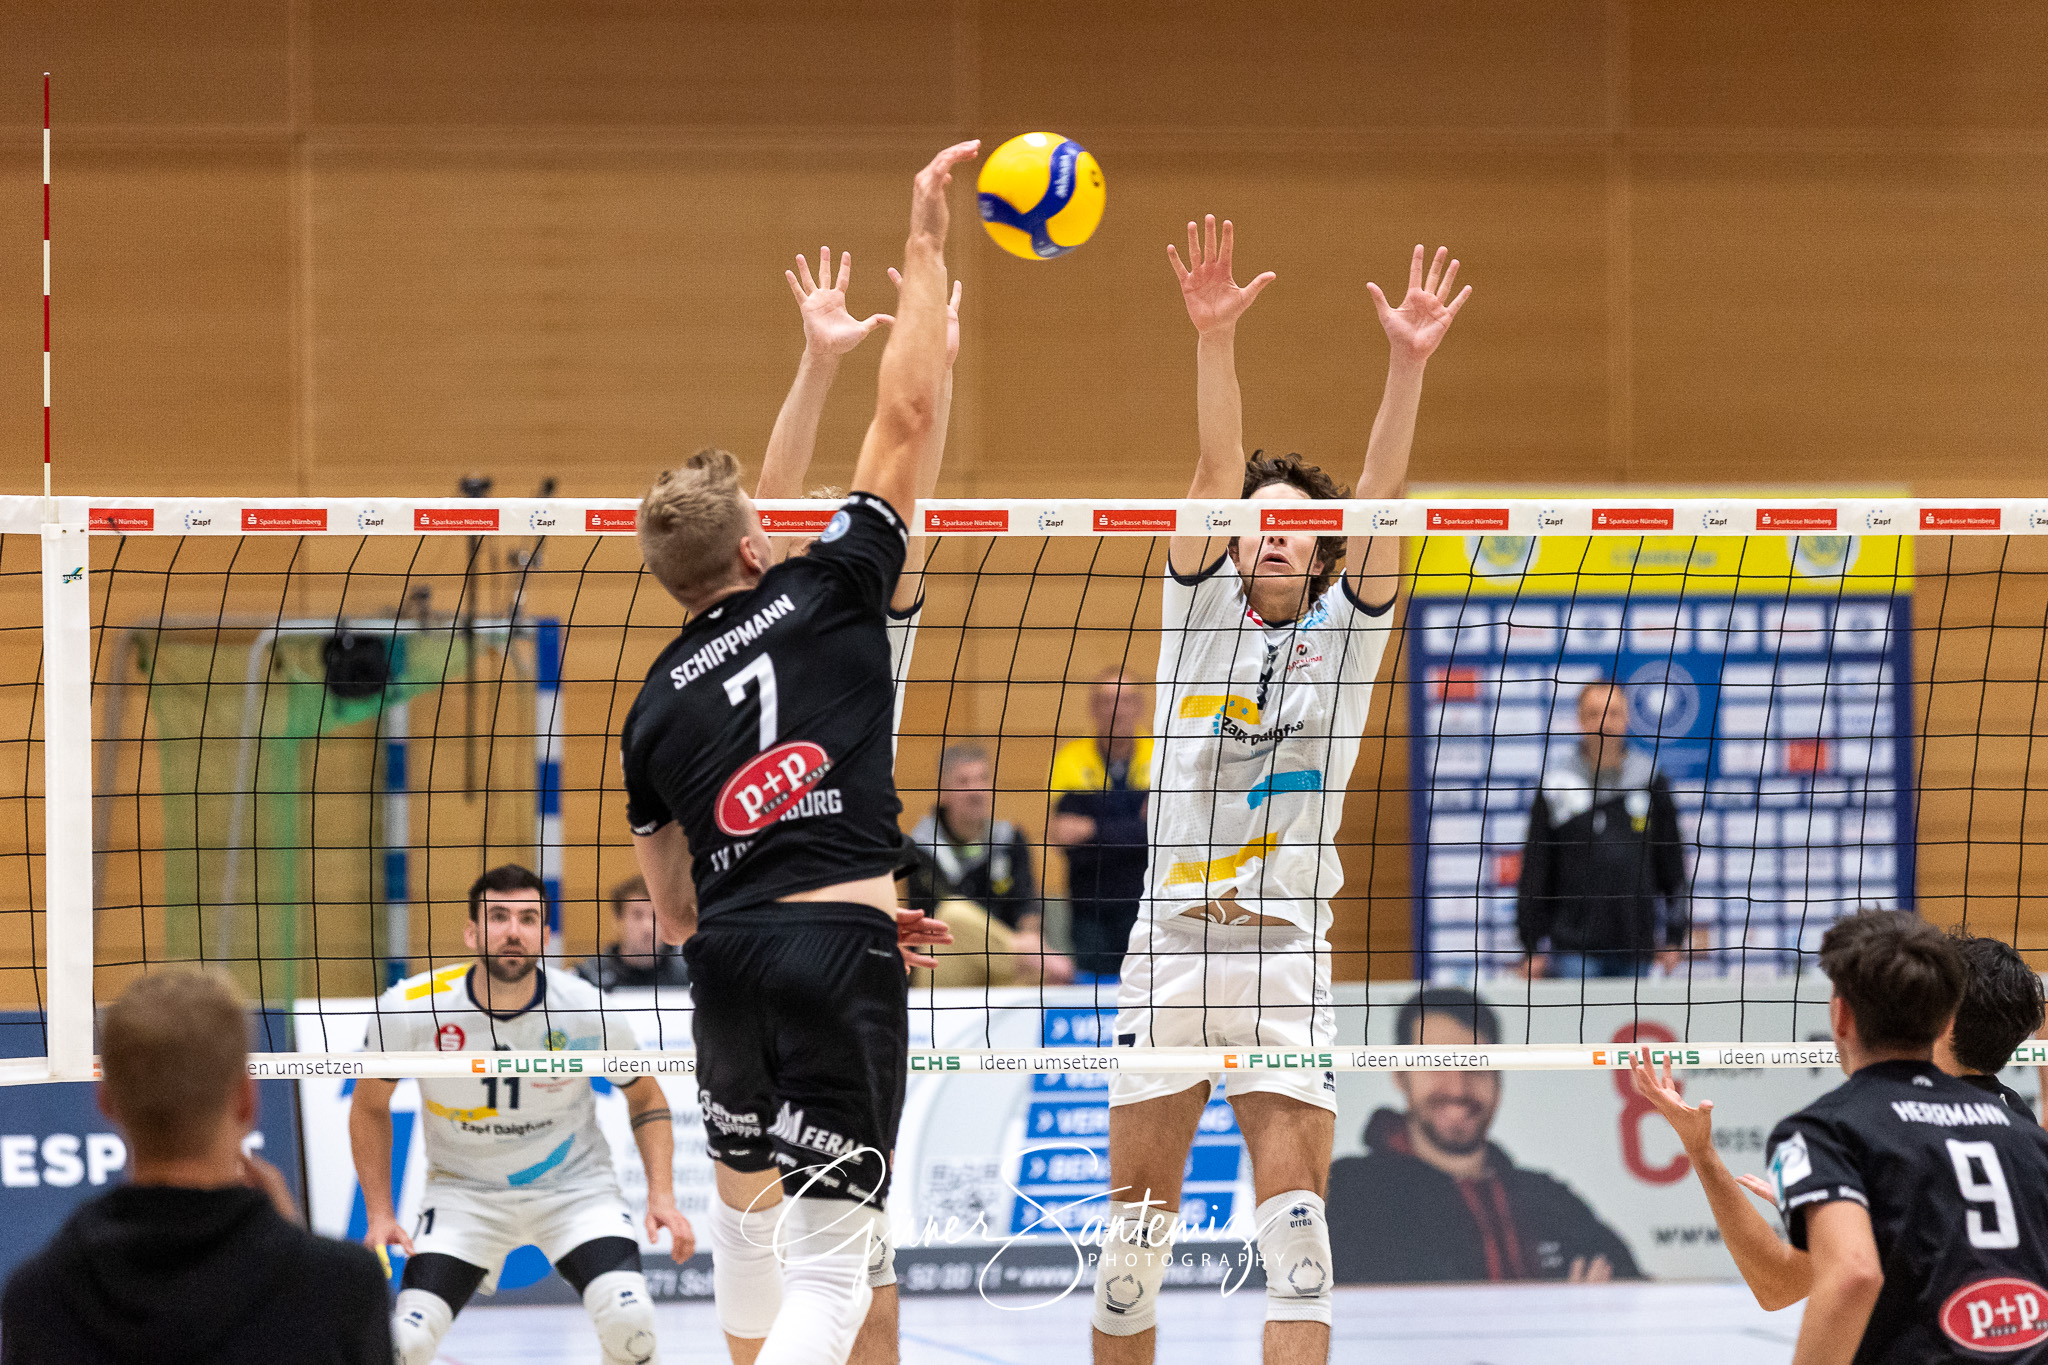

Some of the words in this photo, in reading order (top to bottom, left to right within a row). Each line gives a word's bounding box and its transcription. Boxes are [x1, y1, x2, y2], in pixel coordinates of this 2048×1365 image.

[118, 518, 148, 526] Nürnberg
[192, 518, 211, 526] Zapf
[259, 518, 292, 527] Sparkasse
[293, 517, 322, 527] Nürnberg
[365, 518, 384, 527] Zapf
[432, 518, 463, 527] Sparkasse
[464, 517, 493, 527] Nürnberg
[537, 519, 556, 527] Zapf
[603, 519, 634, 528] Sparkasse
[805, 519, 831, 527] Nürnber
[942, 518, 974, 527] Sparkasse
[975, 518, 1003, 527] Nürnberg
[1045, 519, 1064, 528] Zapf
[1110, 518, 1141, 527] Sparkasse
[1142, 518, 1171, 527] Nürnberg
[1213, 519, 1231, 527] Zapf
[1278, 518, 1308, 526] Sparkasse
[1309, 517, 1337, 526] Nürnberg
[1379, 518, 1398, 527] Zapf
[1444, 517, 1474, 526] Sparkasse
[1474, 517, 1503, 526] Nürnberg
[1545, 518, 1563, 527] Zapf
[1609, 517, 1639, 526] Sparkasse
[1639, 517, 1668, 526] Nürnberg
[1709, 518, 1727, 526] Zapf
[1773, 518, 1803, 526] Sparkasse
[1803, 517, 1832, 526] Nürnberg
[1873, 518, 1891, 526] Zapf
[1937, 517, 1966, 526] Sparkasse
[1967, 517, 1995, 526] Nürnberg
[670, 594, 796, 690] SCHIPPMANN
[722, 652, 778, 751] 7
[735, 752, 806, 824] p+p
[1250, 1053, 1333, 1068] FUCHS
[1351, 1052, 1398, 1067] Ideen
[1405, 1052, 1490, 1067] umsetzen
[1719, 1049, 1765, 1064] Ideen
[1772, 1048, 1841, 1064] umsetze
[276, 1059, 363, 1075] umsetzen
[498, 1058, 583, 1073] FUCHS
[603, 1057, 650, 1073] Ideen
[911, 1056, 961, 1071] CHS
[980, 1055, 1027, 1070] Ideen
[1034, 1054, 1119, 1070] umsetzen
[1891, 1101, 2010, 1127] HERRMANN
[1945, 1138, 2019, 1250] 9
[1967, 1292, 2039, 1339] p+p
